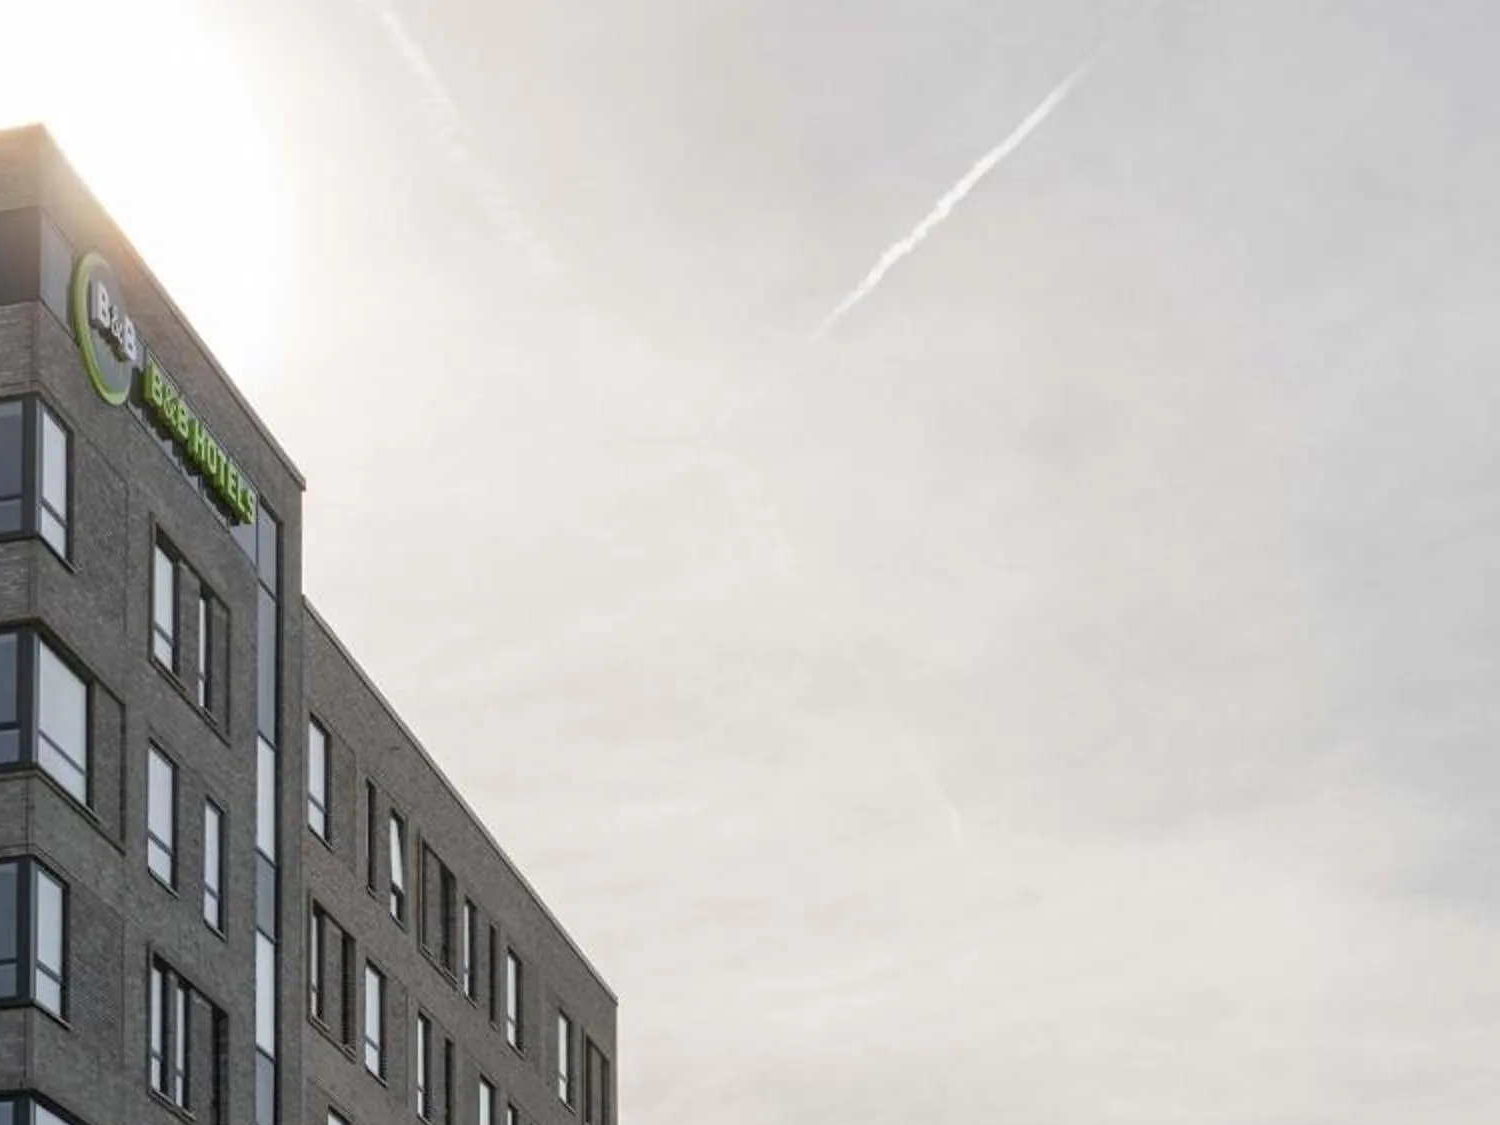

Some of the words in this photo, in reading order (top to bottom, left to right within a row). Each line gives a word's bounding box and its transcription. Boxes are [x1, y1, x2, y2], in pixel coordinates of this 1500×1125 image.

[91, 279, 137, 361] B&B
[145, 361, 189, 441] B&B
[188, 416, 256, 524] HOTELS
